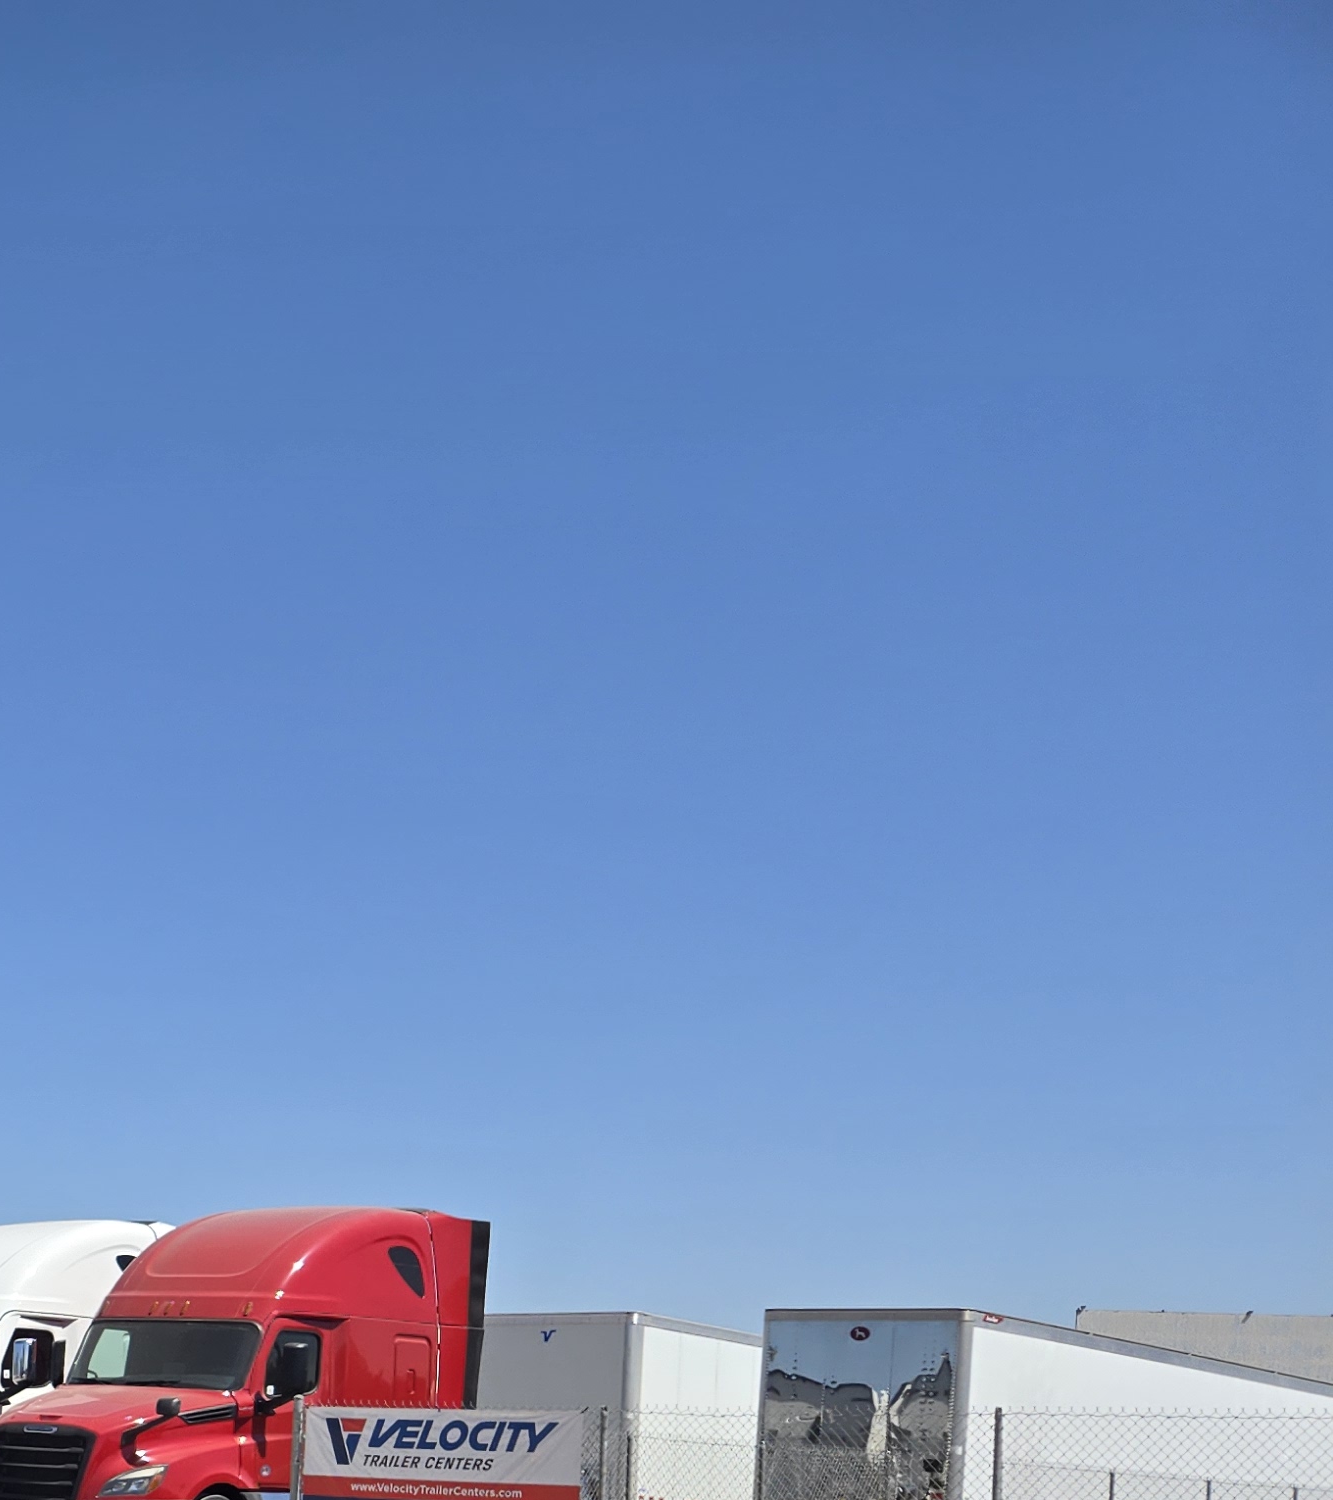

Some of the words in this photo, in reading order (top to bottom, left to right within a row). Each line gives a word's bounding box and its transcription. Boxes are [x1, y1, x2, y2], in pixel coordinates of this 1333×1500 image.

[367, 1418, 560, 1452] VELOCITY
[363, 1454, 420, 1470] TRAILER
[424, 1456, 494, 1472] CENTERS
[350, 1482, 523, 1499] www.VelocityTrailerCenters.com
